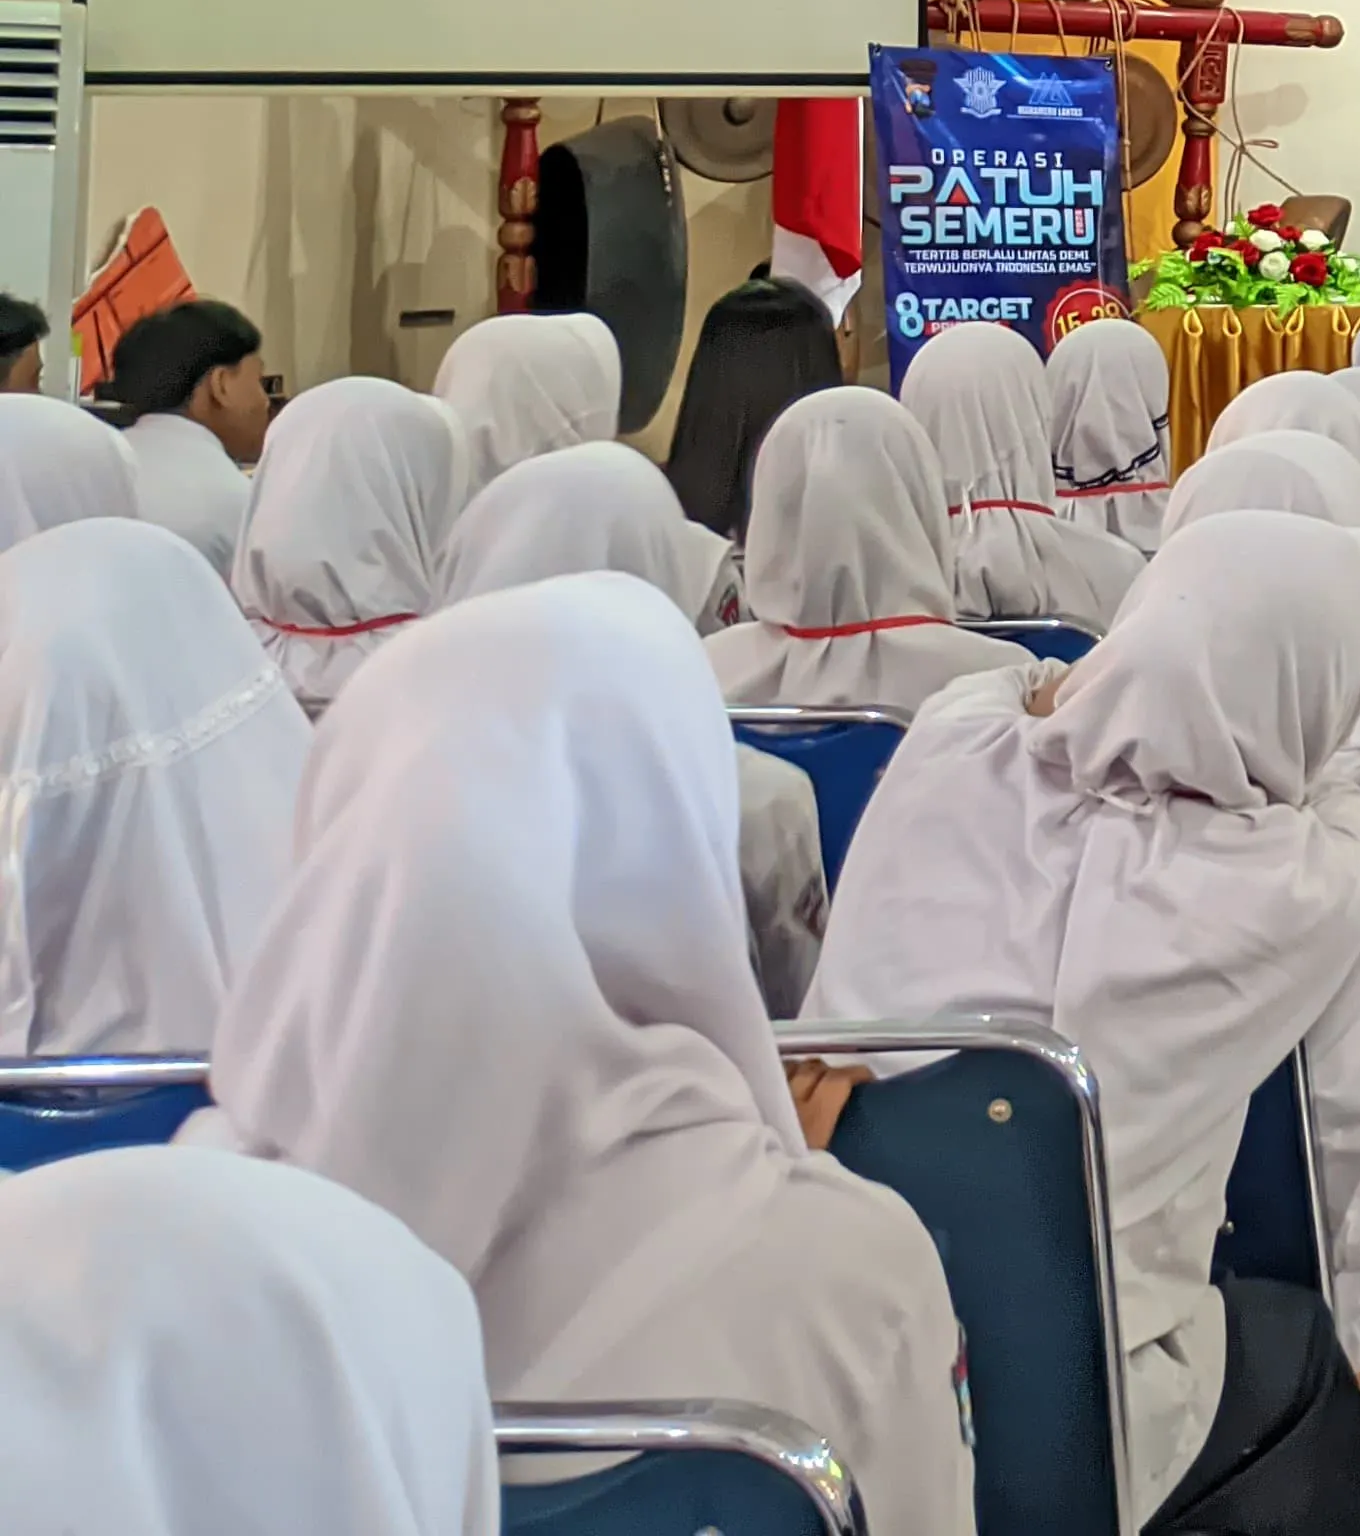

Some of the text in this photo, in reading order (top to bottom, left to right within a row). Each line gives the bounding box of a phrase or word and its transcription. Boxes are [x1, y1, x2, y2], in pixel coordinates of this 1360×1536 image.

[931, 147, 1064, 168] OPERASI
[888, 165, 1104, 207] PATUH
[900, 206, 1096, 246] SEMERU
[904, 261, 993, 274] TERWUJUDNYA
[995, 262, 1057, 274] INDONESIA
[962, 249, 1015, 261] BERLALU
[1017, 250, 1057, 261] LINTAS
[1059, 250, 1090, 261] DEMI
[895, 291, 1033, 339] 8 TARGET
